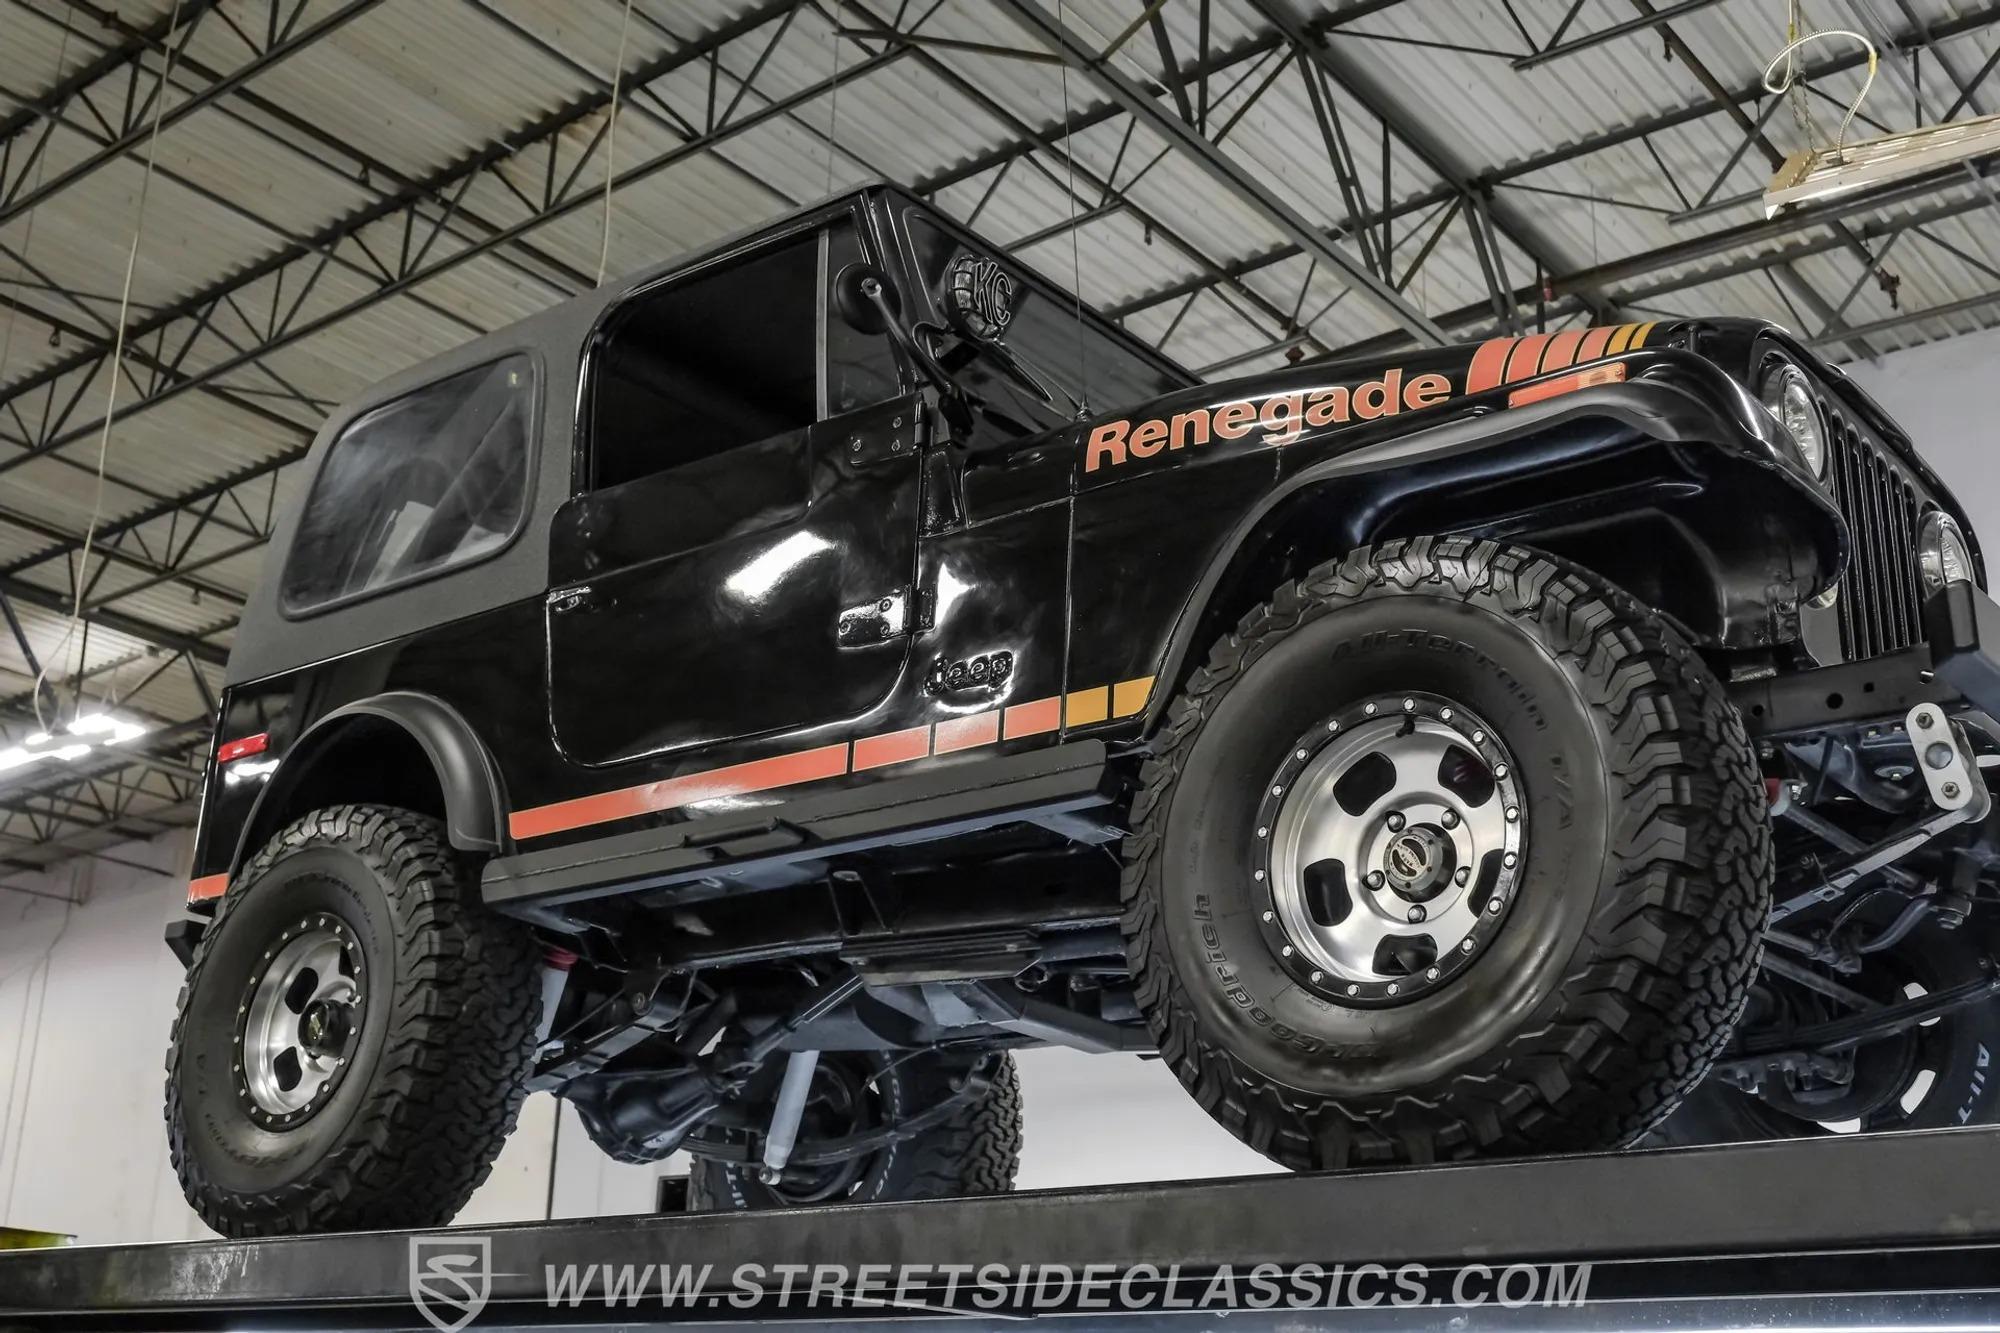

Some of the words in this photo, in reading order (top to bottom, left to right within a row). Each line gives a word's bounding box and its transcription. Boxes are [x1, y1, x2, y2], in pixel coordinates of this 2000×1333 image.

[974, 261, 1013, 326] KC
[1085, 368, 1451, 473] Renegade
[922, 649, 1014, 698] Jeep
